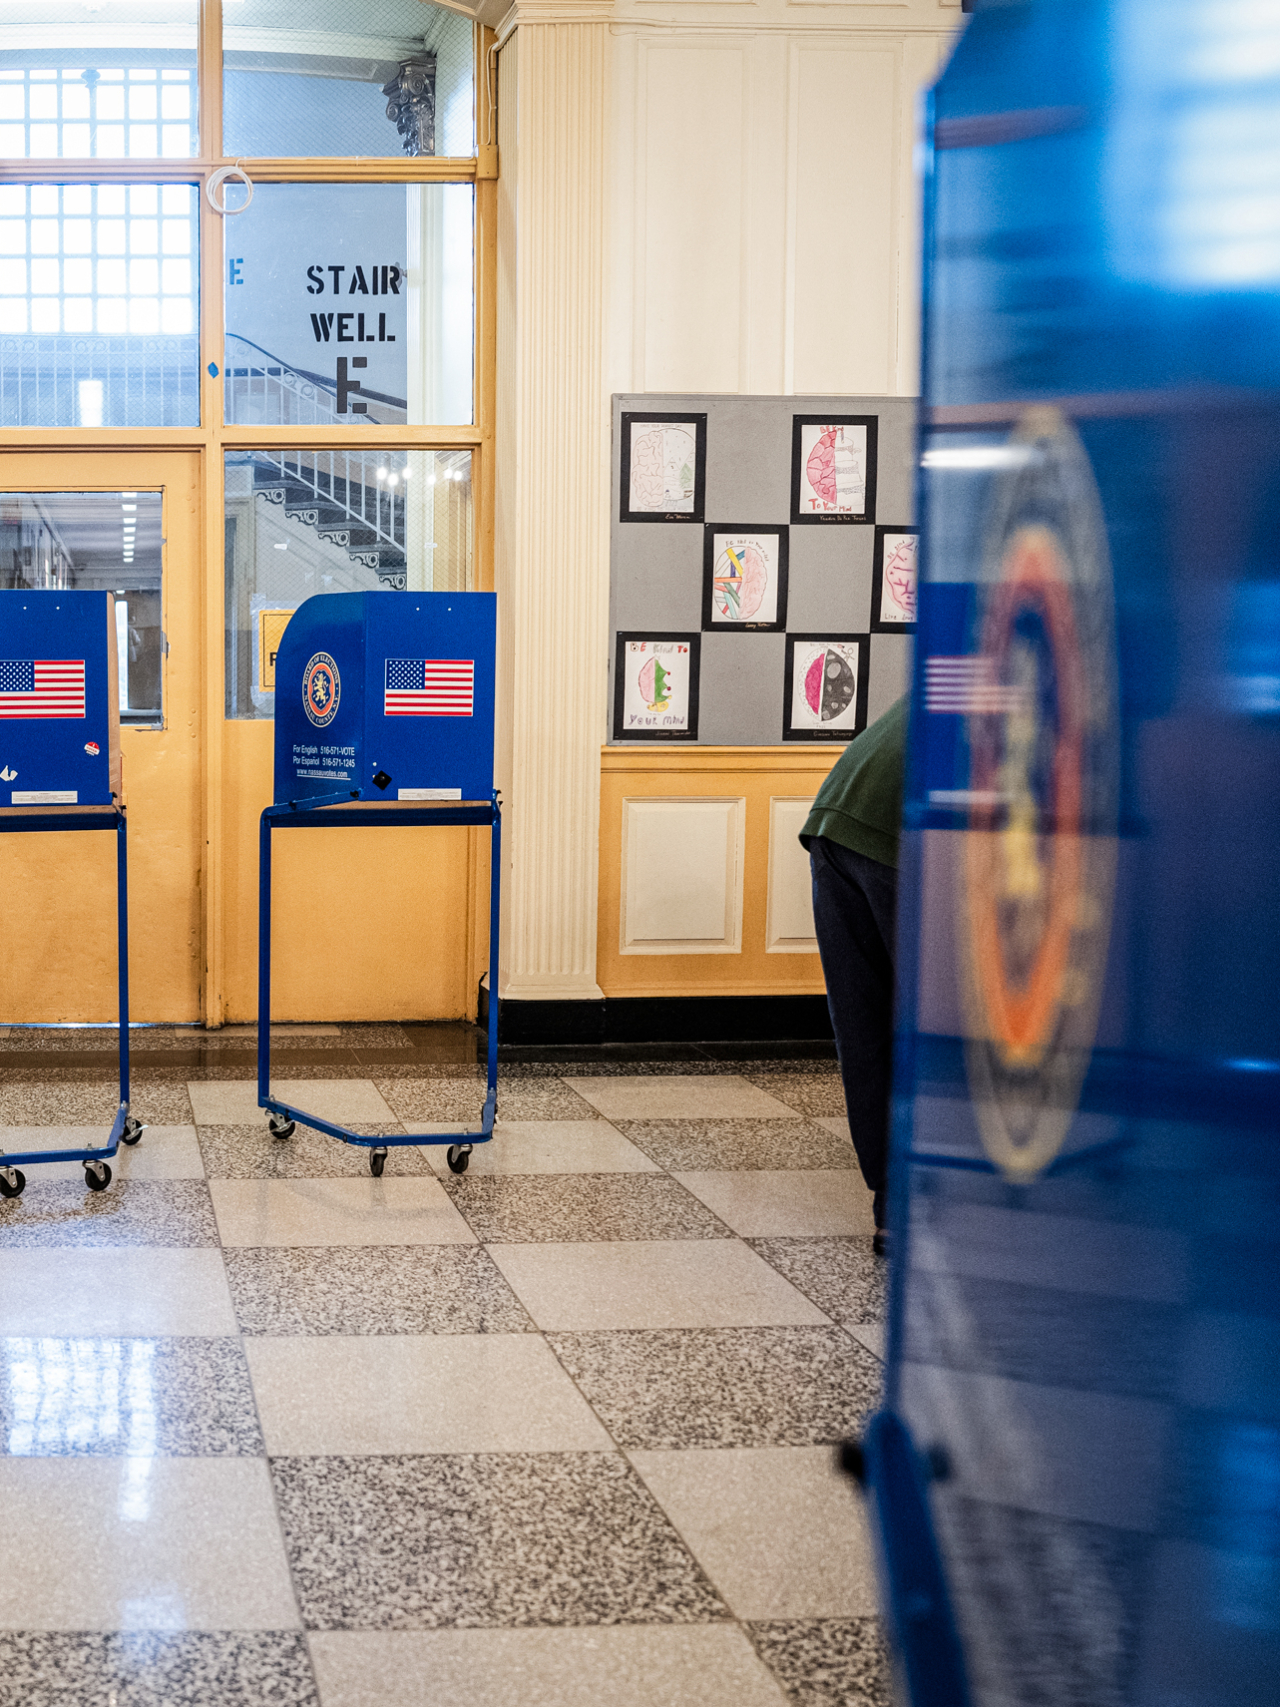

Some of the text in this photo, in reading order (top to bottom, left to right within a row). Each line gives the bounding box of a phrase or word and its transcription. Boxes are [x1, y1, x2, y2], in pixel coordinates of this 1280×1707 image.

[306, 266, 400, 295] STAIR
[310, 312, 396, 342] WELL
[336, 356, 368, 414] E
[630, 642, 647, 652] BE
[301, 745, 318, 755] English
[320, 746, 355, 756] 516-571-VOTE
[301, 757, 319, 766] Español
[322, 758, 355, 768] 516-571-1245
